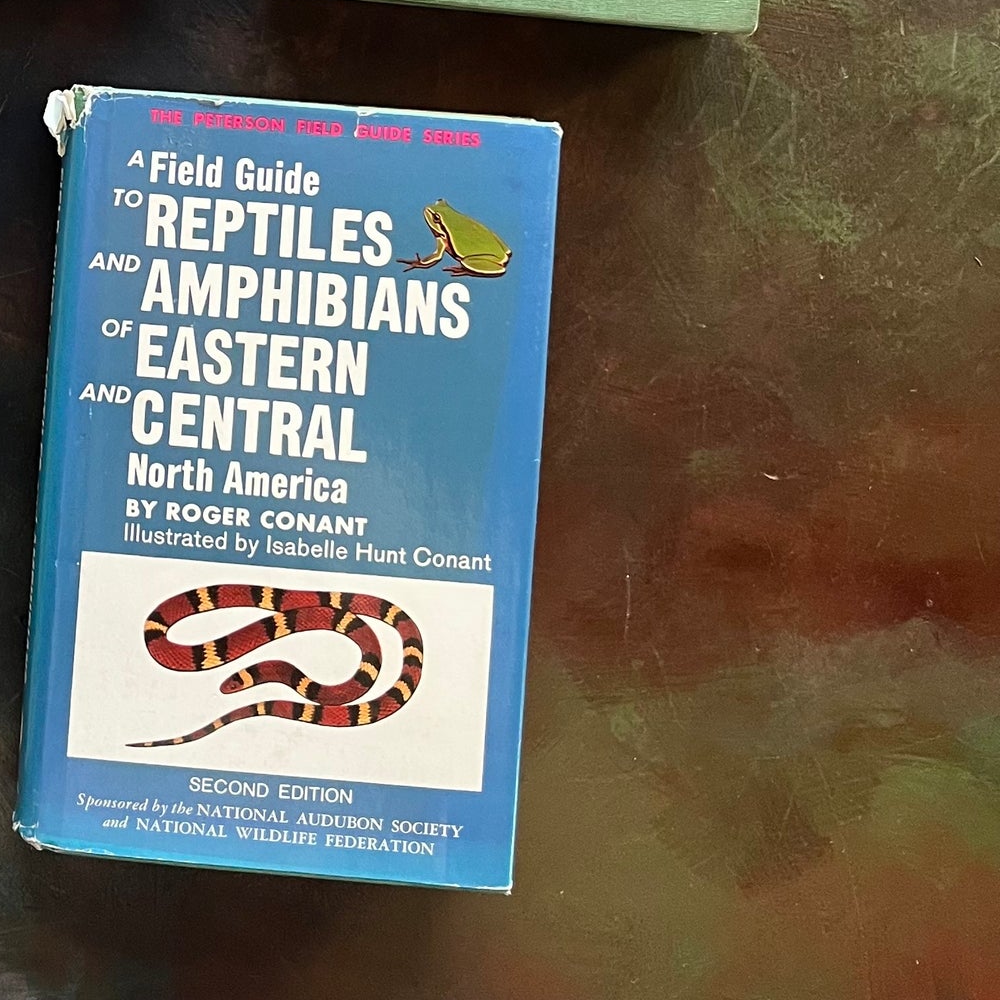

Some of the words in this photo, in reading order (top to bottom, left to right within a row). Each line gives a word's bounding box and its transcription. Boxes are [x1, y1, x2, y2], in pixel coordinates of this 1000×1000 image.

[151, 109, 182, 125] THE
[193, 113, 285, 133] PETERSON
[296, 119, 343, 137] FIELD
[356, 124, 411, 143] GUIDE
[423, 129, 481, 147] SERIES
[128, 150, 145, 168] A
[149, 151, 223, 189] Field
[235, 157, 320, 196] Guide
[112, 189, 143, 208] TO
[145, 193, 393, 267] REPTILES
[89, 253, 140, 273] AND
[140, 258, 471, 339] AMPHIBIANS
[102, 319, 133, 338] OF
[136, 324, 368, 397] EASTERN
[79, 384, 131, 404] AND
[131, 389, 367, 463] CENTRAL
[127, 452, 212, 493] North
[223, 461, 348, 504] America
[125, 499, 159, 520] BY
[165, 501, 250, 527] ROGER
[260, 508, 367, 536] CONANT
[124, 522, 228, 552] Illustrated
[234, 530, 259, 558] by
[266, 535, 348, 560] Isabelle
[355, 543, 407, 565] Hunt
[413, 547, 492, 572] Conant
[189, 777, 270, 799] SECOND
[279, 785, 353, 804] EDITION
[76, 792, 148, 815] Sponsored
[151, 798, 168, 814] by
[171, 801, 193, 816] the
[196, 803, 289, 824] NATIONAL
[296, 813, 384, 831] AUDUBON
[391, 820, 463, 838] SOCIETY
[102, 816, 127, 829] and
[136, 817, 228, 838] NATIONAL
[235, 827, 317, 846] WILDLIFE
[325, 834, 434, 856] FEDERATION
